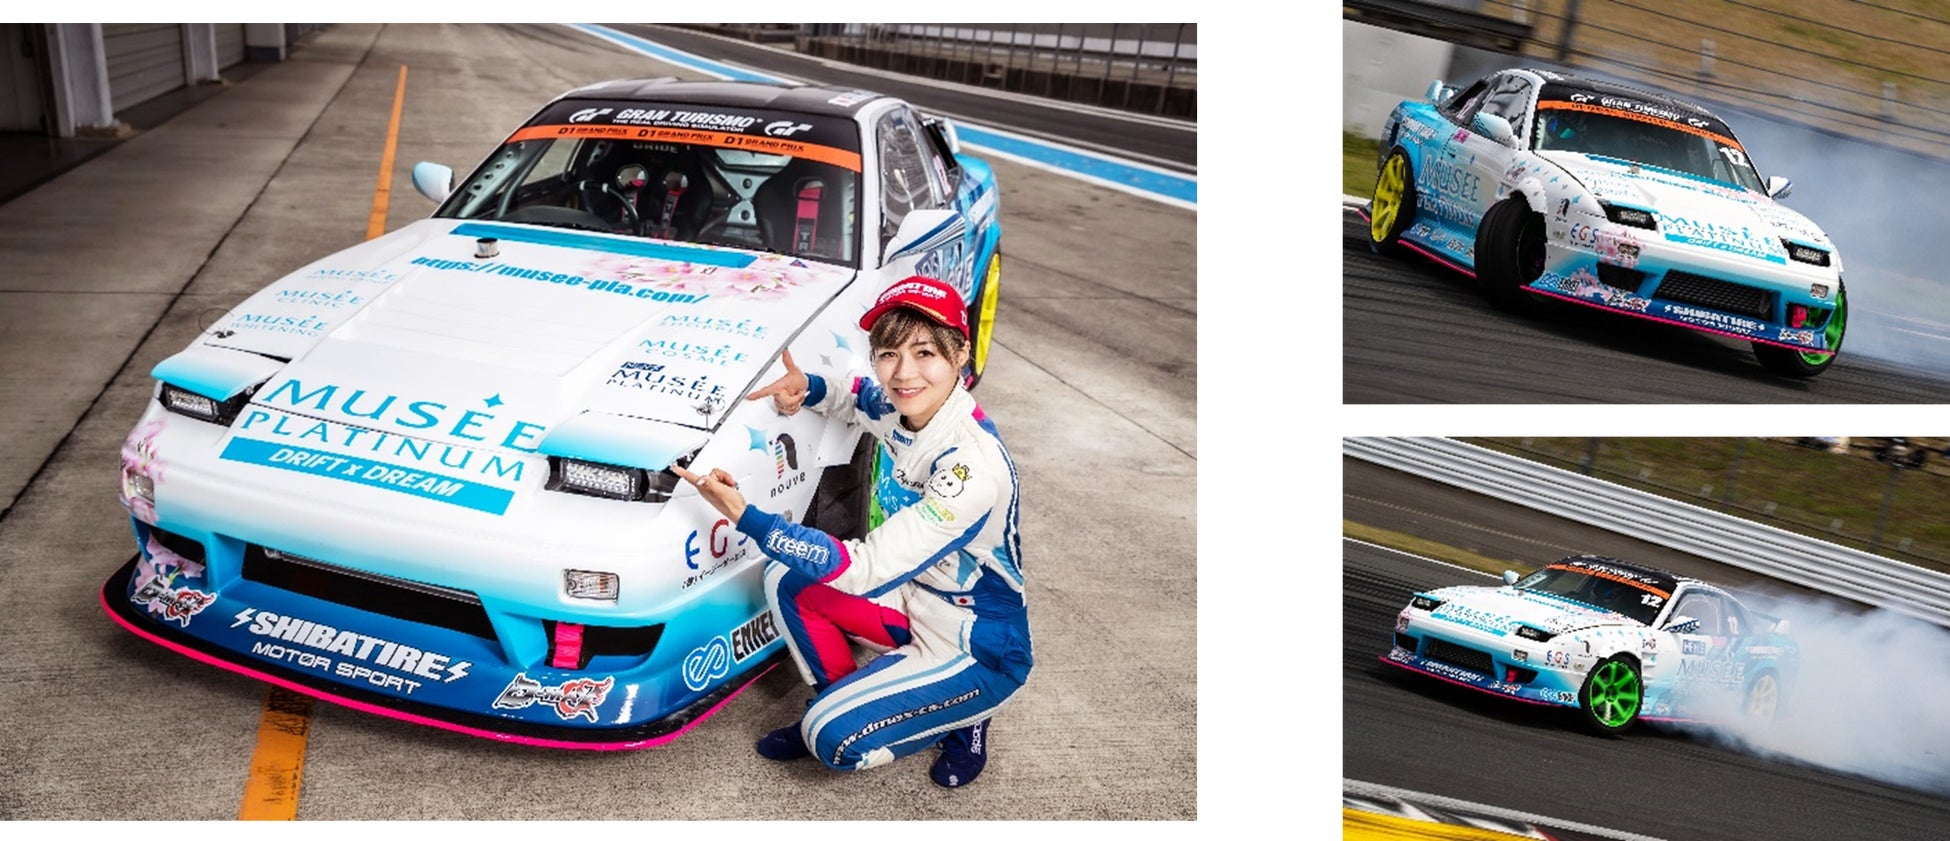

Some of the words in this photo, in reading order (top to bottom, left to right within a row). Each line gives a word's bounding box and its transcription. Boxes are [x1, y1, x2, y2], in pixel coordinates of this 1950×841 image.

[558, 126, 576, 135] D1
[606, 128, 628, 136] PRIX
[616, 108, 669, 121] GRAN
[670, 110, 755, 128] TURISMO
[638, 129, 656, 138] D1
[657, 130, 690, 140] GRAND
[691, 132, 714, 142] PRIX
[724, 136, 744, 146] D1
[744, 138, 780, 149] GRAND
[780, 143, 805, 152] PRIX
[1719, 147, 1750, 169] 12
[411, 255, 710, 304] https://musee-pla.com/
[241, 410, 526, 483] PLATINUM
[268, 447, 346, 475] DRIFT
[358, 465, 466, 497] DREAM
[766, 528, 831, 565] freem
[1640, 593, 1664, 608] 12
[249, 611, 453, 682] SHIBATIRE
[335, 661, 422, 694] SPORT
